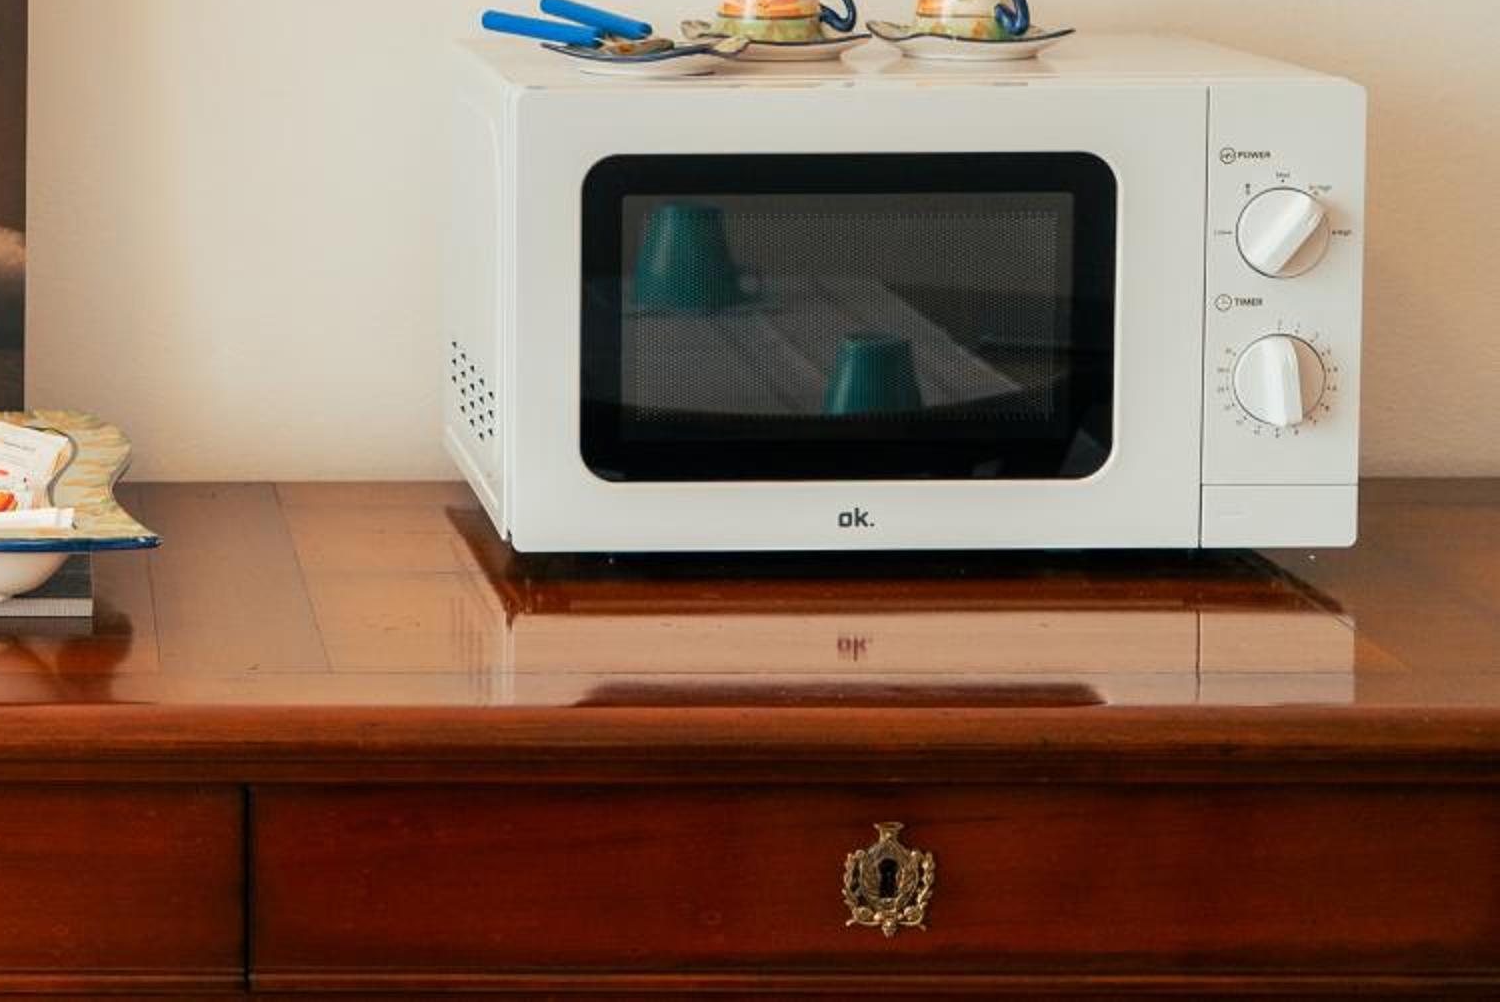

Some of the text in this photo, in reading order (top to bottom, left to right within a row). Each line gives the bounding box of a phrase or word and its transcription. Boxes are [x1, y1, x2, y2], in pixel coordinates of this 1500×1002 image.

[1237, 150, 1272, 159] POWER
[1233, 297, 1263, 306] TIMER
[838, 507, 876, 528] ok.
